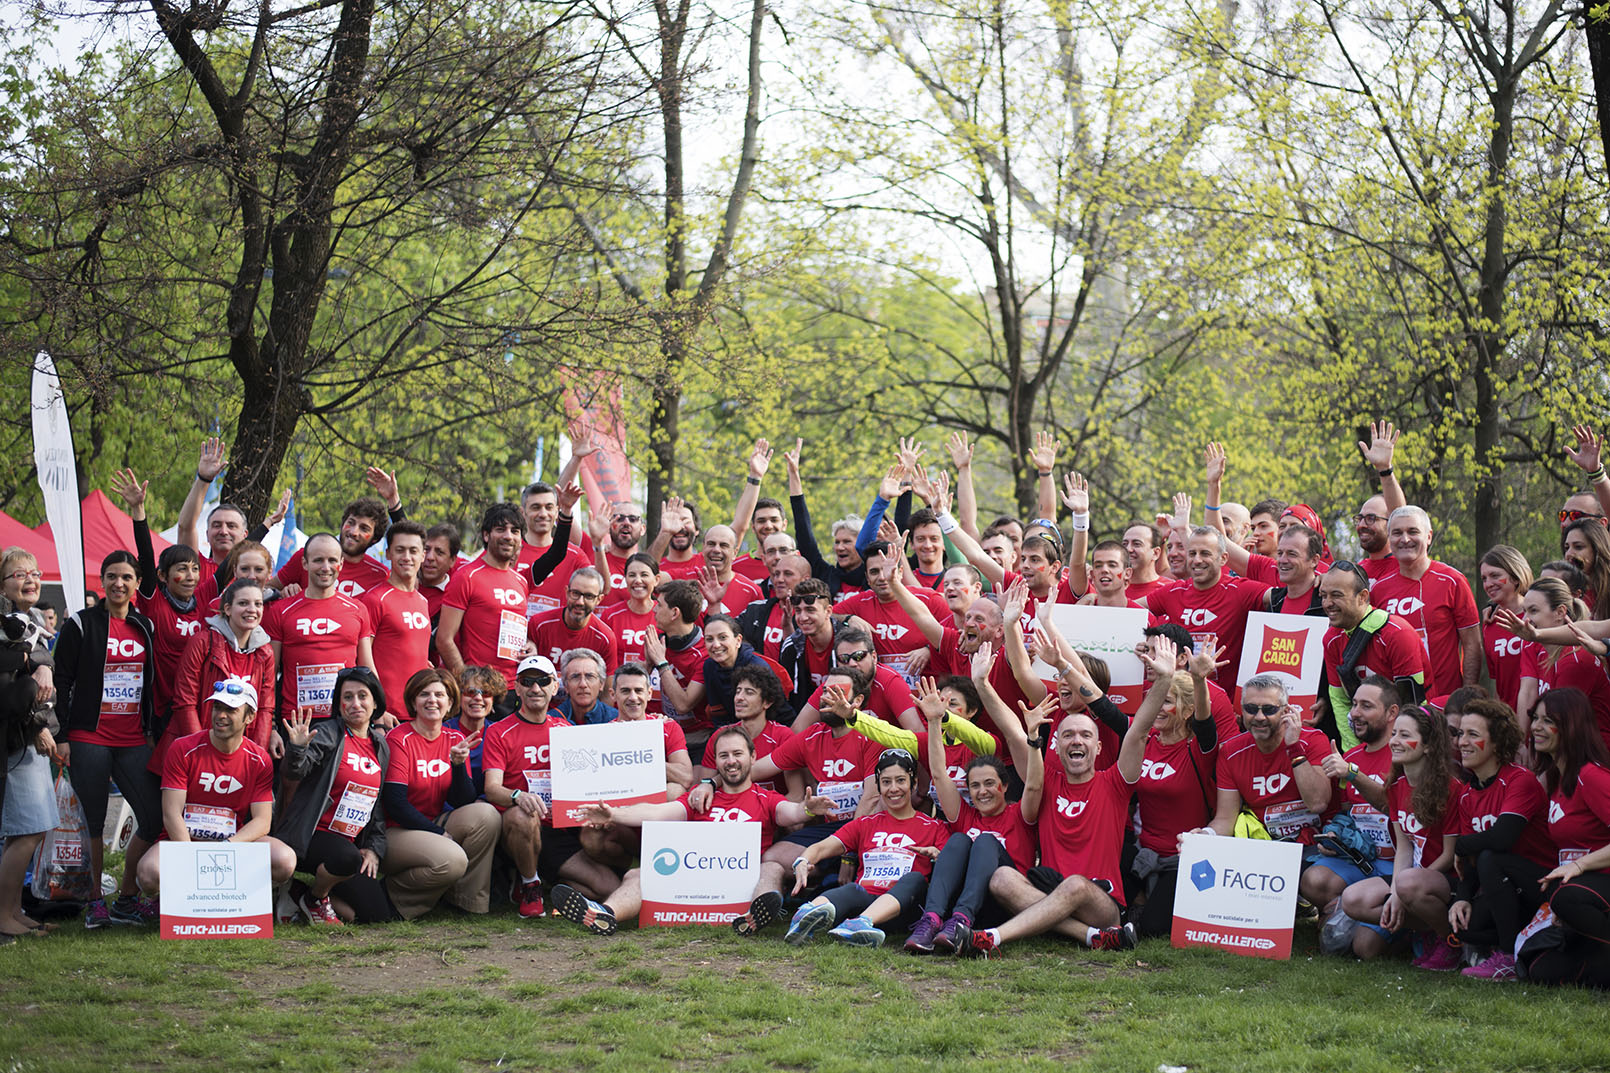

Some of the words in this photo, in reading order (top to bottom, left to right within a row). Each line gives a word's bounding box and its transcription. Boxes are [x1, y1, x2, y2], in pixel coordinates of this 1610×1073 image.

[1270, 637, 1296, 652] SAN
[1262, 650, 1300, 666] CARLO
[104, 688, 134, 697] 1354C
[111, 702, 128, 711] EA7
[683, 851, 749, 870] Cerved
[200, 864, 233, 875] gnosis
[872, 866, 900, 877] 1356A
[1222, 868, 1286, 893] FACTO
[187, 893, 220, 901] advanced
[221, 893, 247, 901] biotech
